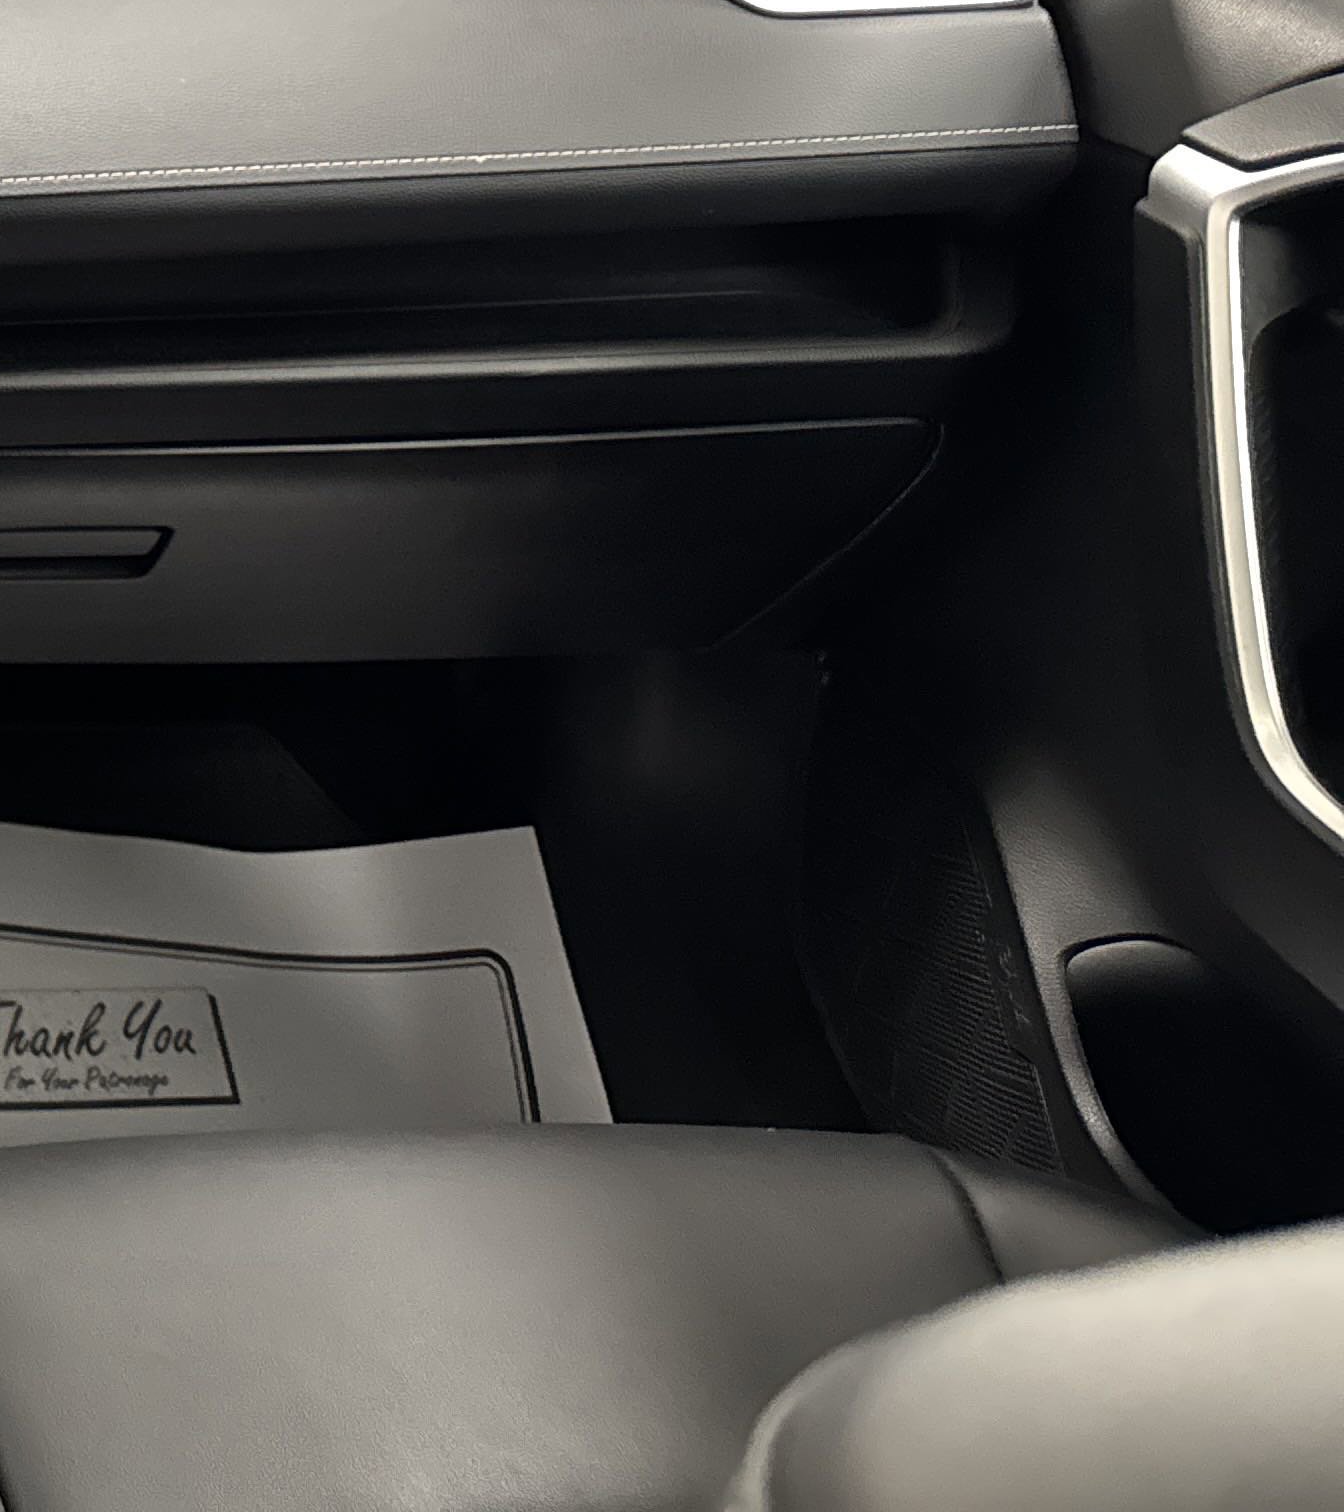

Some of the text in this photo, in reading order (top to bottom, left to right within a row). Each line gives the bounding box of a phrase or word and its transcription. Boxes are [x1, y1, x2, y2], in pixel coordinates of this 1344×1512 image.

[123, 998, 197, 1060] You
[3, 1065, 170, 1096] For Your Patronage
